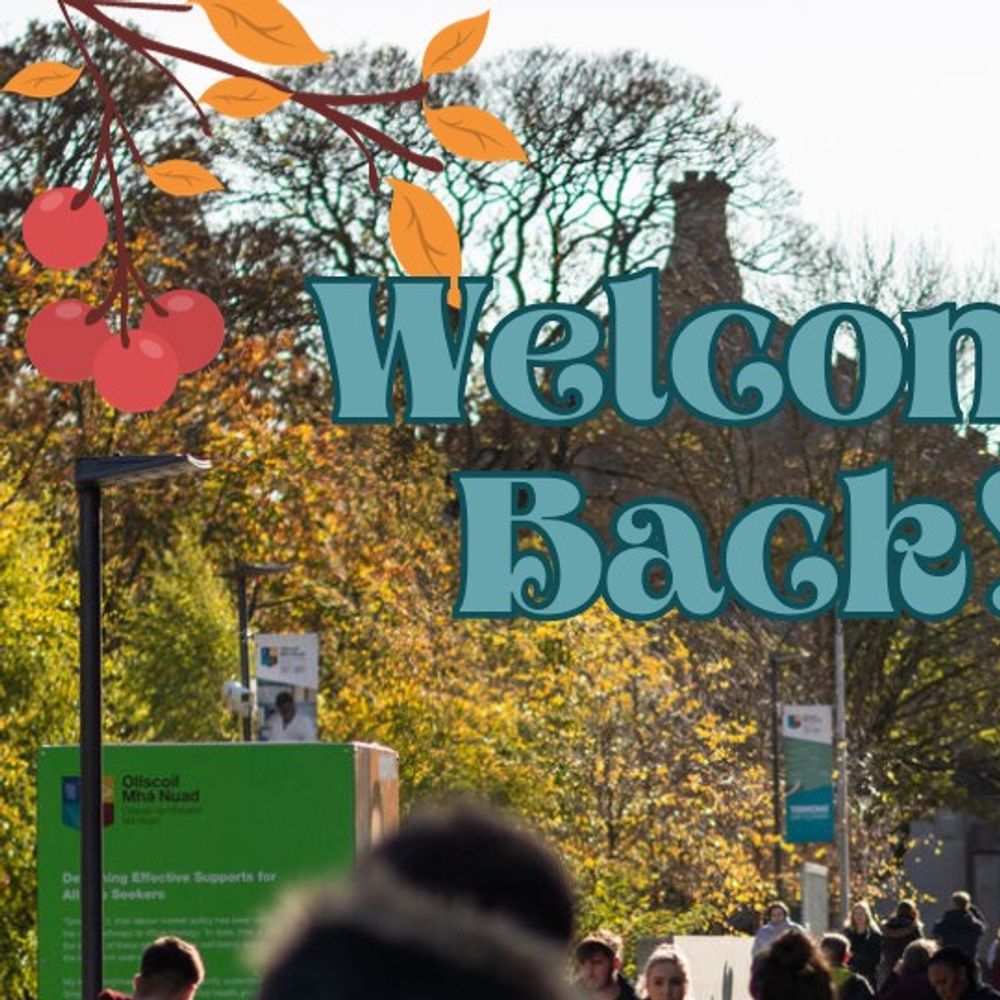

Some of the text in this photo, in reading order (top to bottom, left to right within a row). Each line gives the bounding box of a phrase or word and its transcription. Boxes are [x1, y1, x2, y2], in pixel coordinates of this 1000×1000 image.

[131, 872, 190, 884] Effective
[193, 871, 254, 885] Supports
[258, 871, 277, 883] for
[111, 889, 166, 901] Seekers
